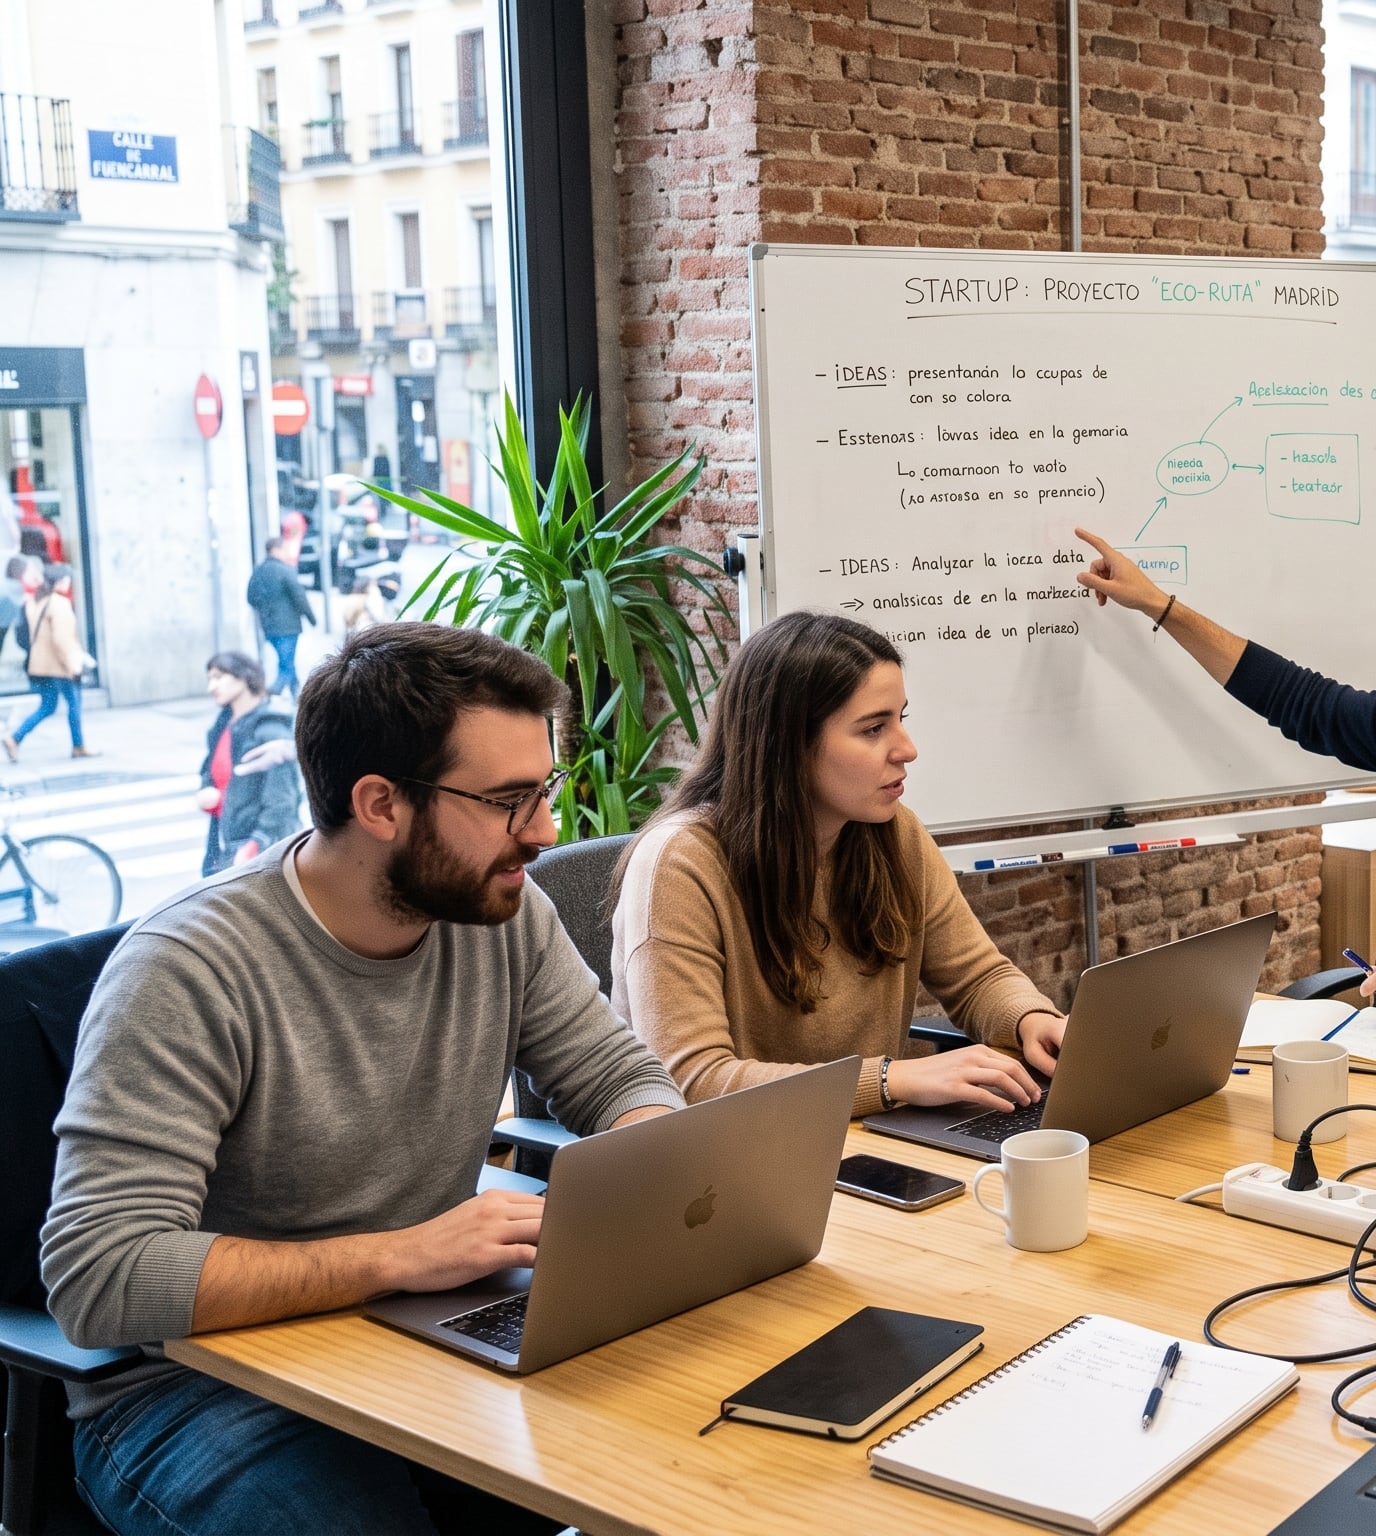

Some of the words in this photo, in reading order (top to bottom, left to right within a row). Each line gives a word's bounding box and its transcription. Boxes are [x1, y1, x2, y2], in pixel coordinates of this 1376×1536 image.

[112, 132, 154, 150] CALLE
[92, 160, 177, 181] FUENCARRAL
[1044, 277, 1140, 303] PROYECTO
[1092, 364, 1108, 380] de
[909, 393, 933, 404] con
[942, 393, 957, 404] so
[989, 425, 1020, 441] idea
[1028, 429, 1045, 440] en
[1052, 424, 1065, 439] la
[1008, 459, 1024, 474] to
[988, 491, 1004, 501] en
[911, 555, 975, 576] Analyzar
[983, 552, 998, 568] la
[1052, 548, 1086, 565] data
[953, 589, 972, 606] de
[980, 593, 998, 604] en
[1004, 587, 1018, 602] la
[937, 624, 967, 641] idea
[975, 624, 992, 640] de
[1001, 626, 1018, 638] un
